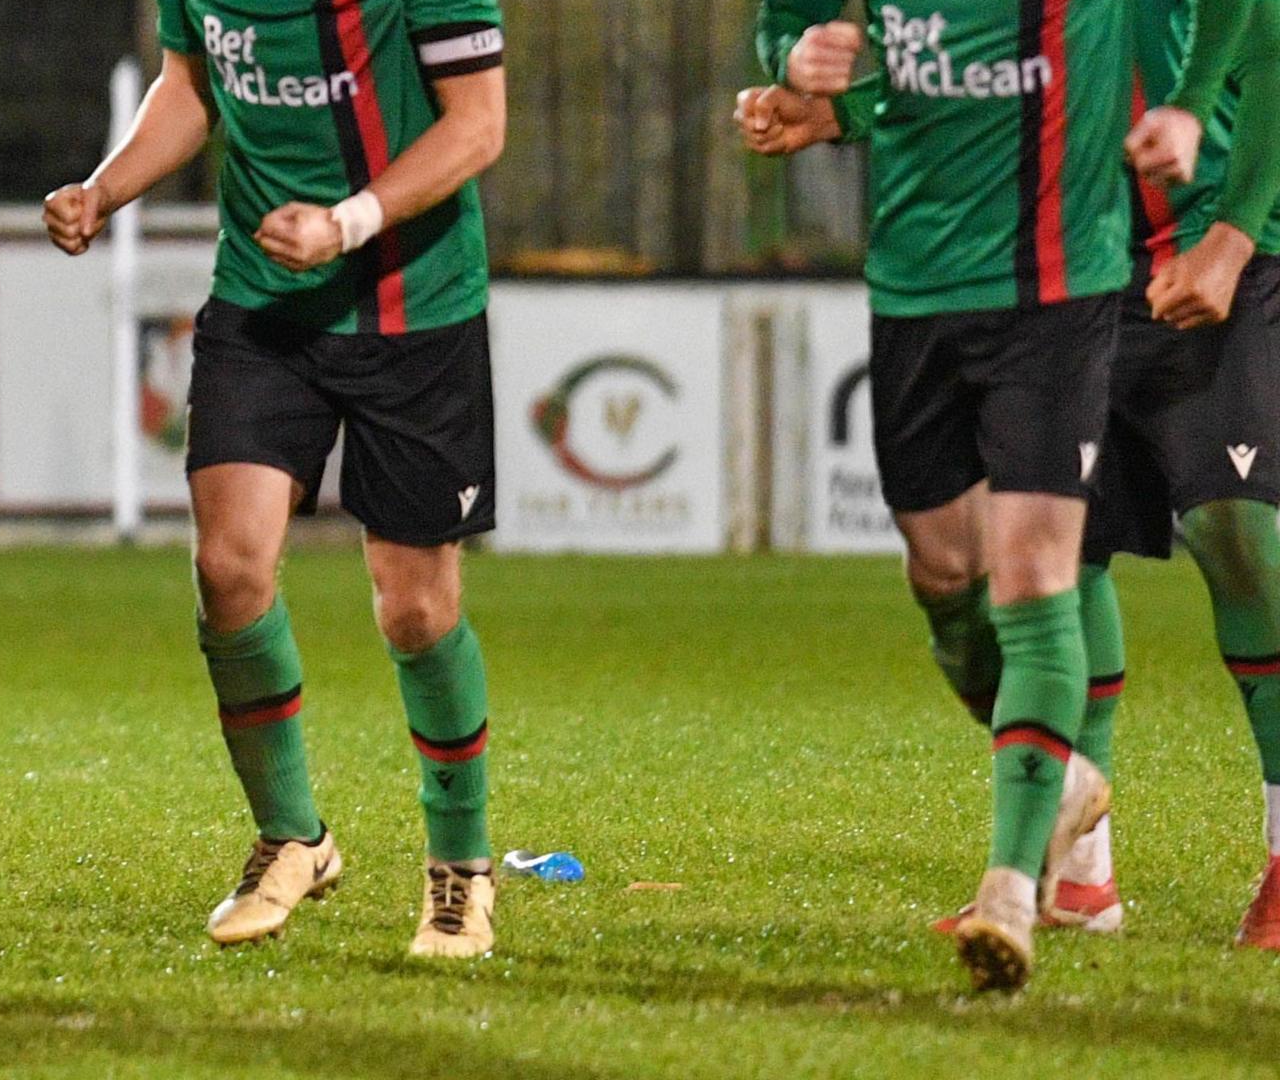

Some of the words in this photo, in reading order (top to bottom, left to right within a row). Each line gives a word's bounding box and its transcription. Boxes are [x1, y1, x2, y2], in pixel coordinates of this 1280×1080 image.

[203, 14, 256, 64] Bet
[881, 4, 946, 53] Bet
[214, 56, 358, 106] McLean
[886, 47, 1052, 98] McLean
